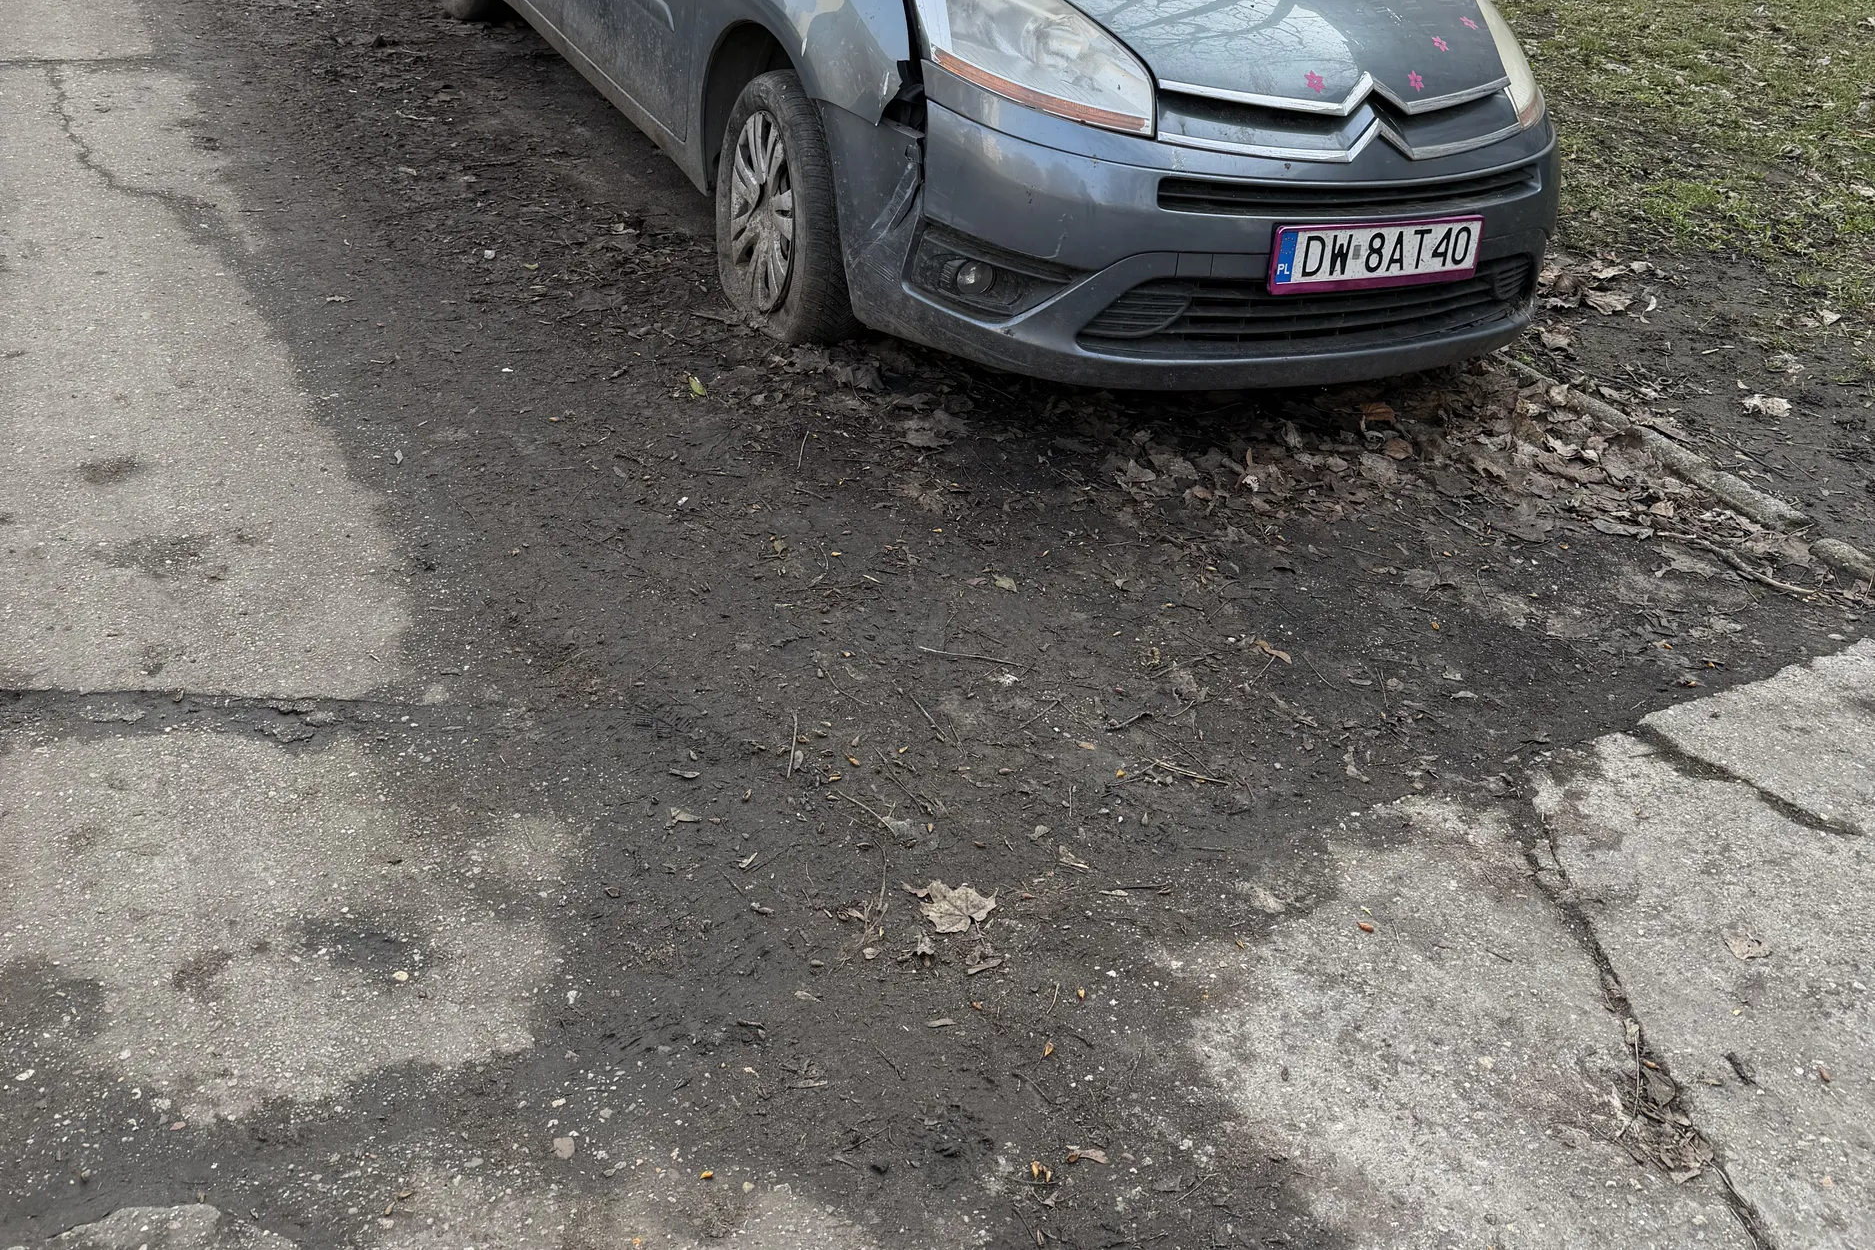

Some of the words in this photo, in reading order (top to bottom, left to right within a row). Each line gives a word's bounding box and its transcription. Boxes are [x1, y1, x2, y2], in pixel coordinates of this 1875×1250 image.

[1301, 234, 1353, 277] DW
[1364, 226, 1472, 273] 8AT40
[1276, 263, 1290, 275] PL
